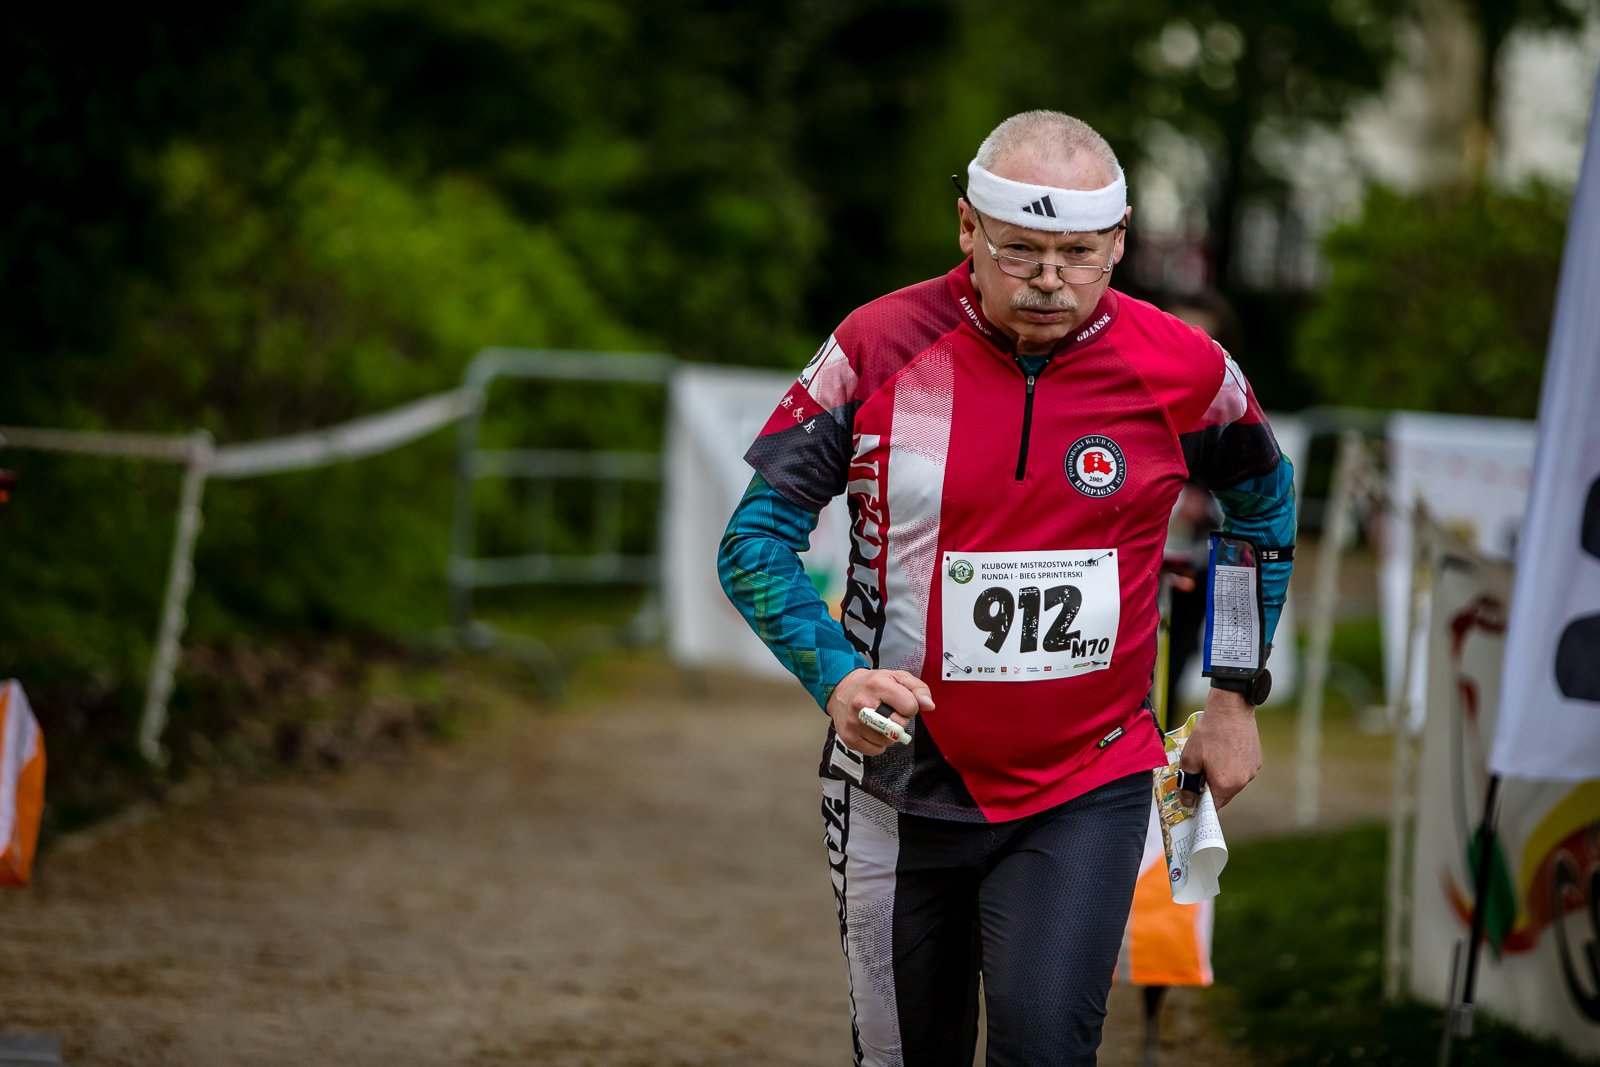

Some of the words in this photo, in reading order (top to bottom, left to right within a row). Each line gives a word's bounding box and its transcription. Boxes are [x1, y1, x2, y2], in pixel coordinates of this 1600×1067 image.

[1076, 312, 1111, 342] GDAŃSK
[1068, 441, 1085, 478] POMORSKI
[1085, 437, 1107, 446] KLUB
[1074, 479, 1116, 496] HARPAGAN
[1089, 475, 1103, 483] 2005
[981, 562, 1018, 570] KLUBOWE
[1020, 560, 1073, 569] MISTRZOSTWA
[1019, 572, 1036, 580] BIEG
[1038, 571, 1083, 579] SPRINTERSKI
[973, 584, 1082, 654] 912
[1071, 637, 1110, 659] M70
